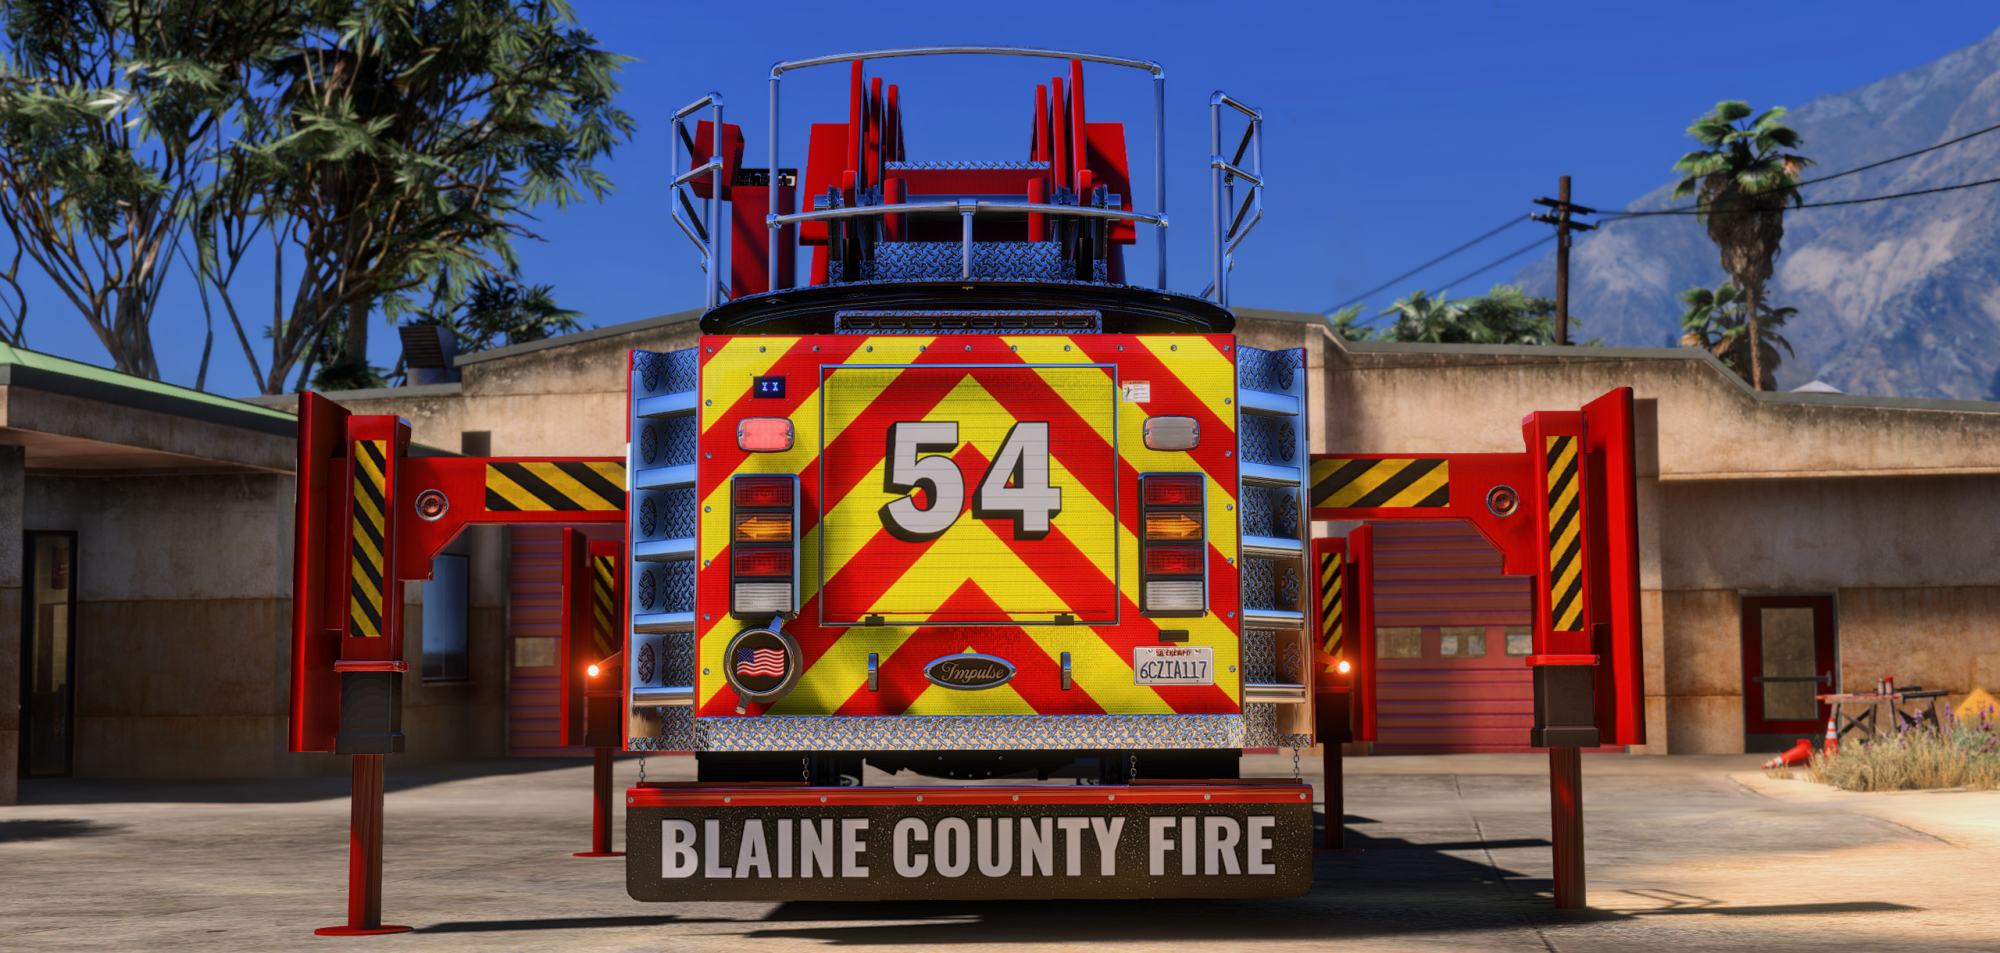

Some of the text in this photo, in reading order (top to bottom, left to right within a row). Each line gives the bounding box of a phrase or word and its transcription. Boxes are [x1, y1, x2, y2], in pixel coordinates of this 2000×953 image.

[878, 421, 1062, 543] 54
[941, 661, 1004, 683] Impulse
[1140, 660, 1208, 678] 6CZIA117
[660, 815, 1277, 879] BLAINE COUNTY FIRE
